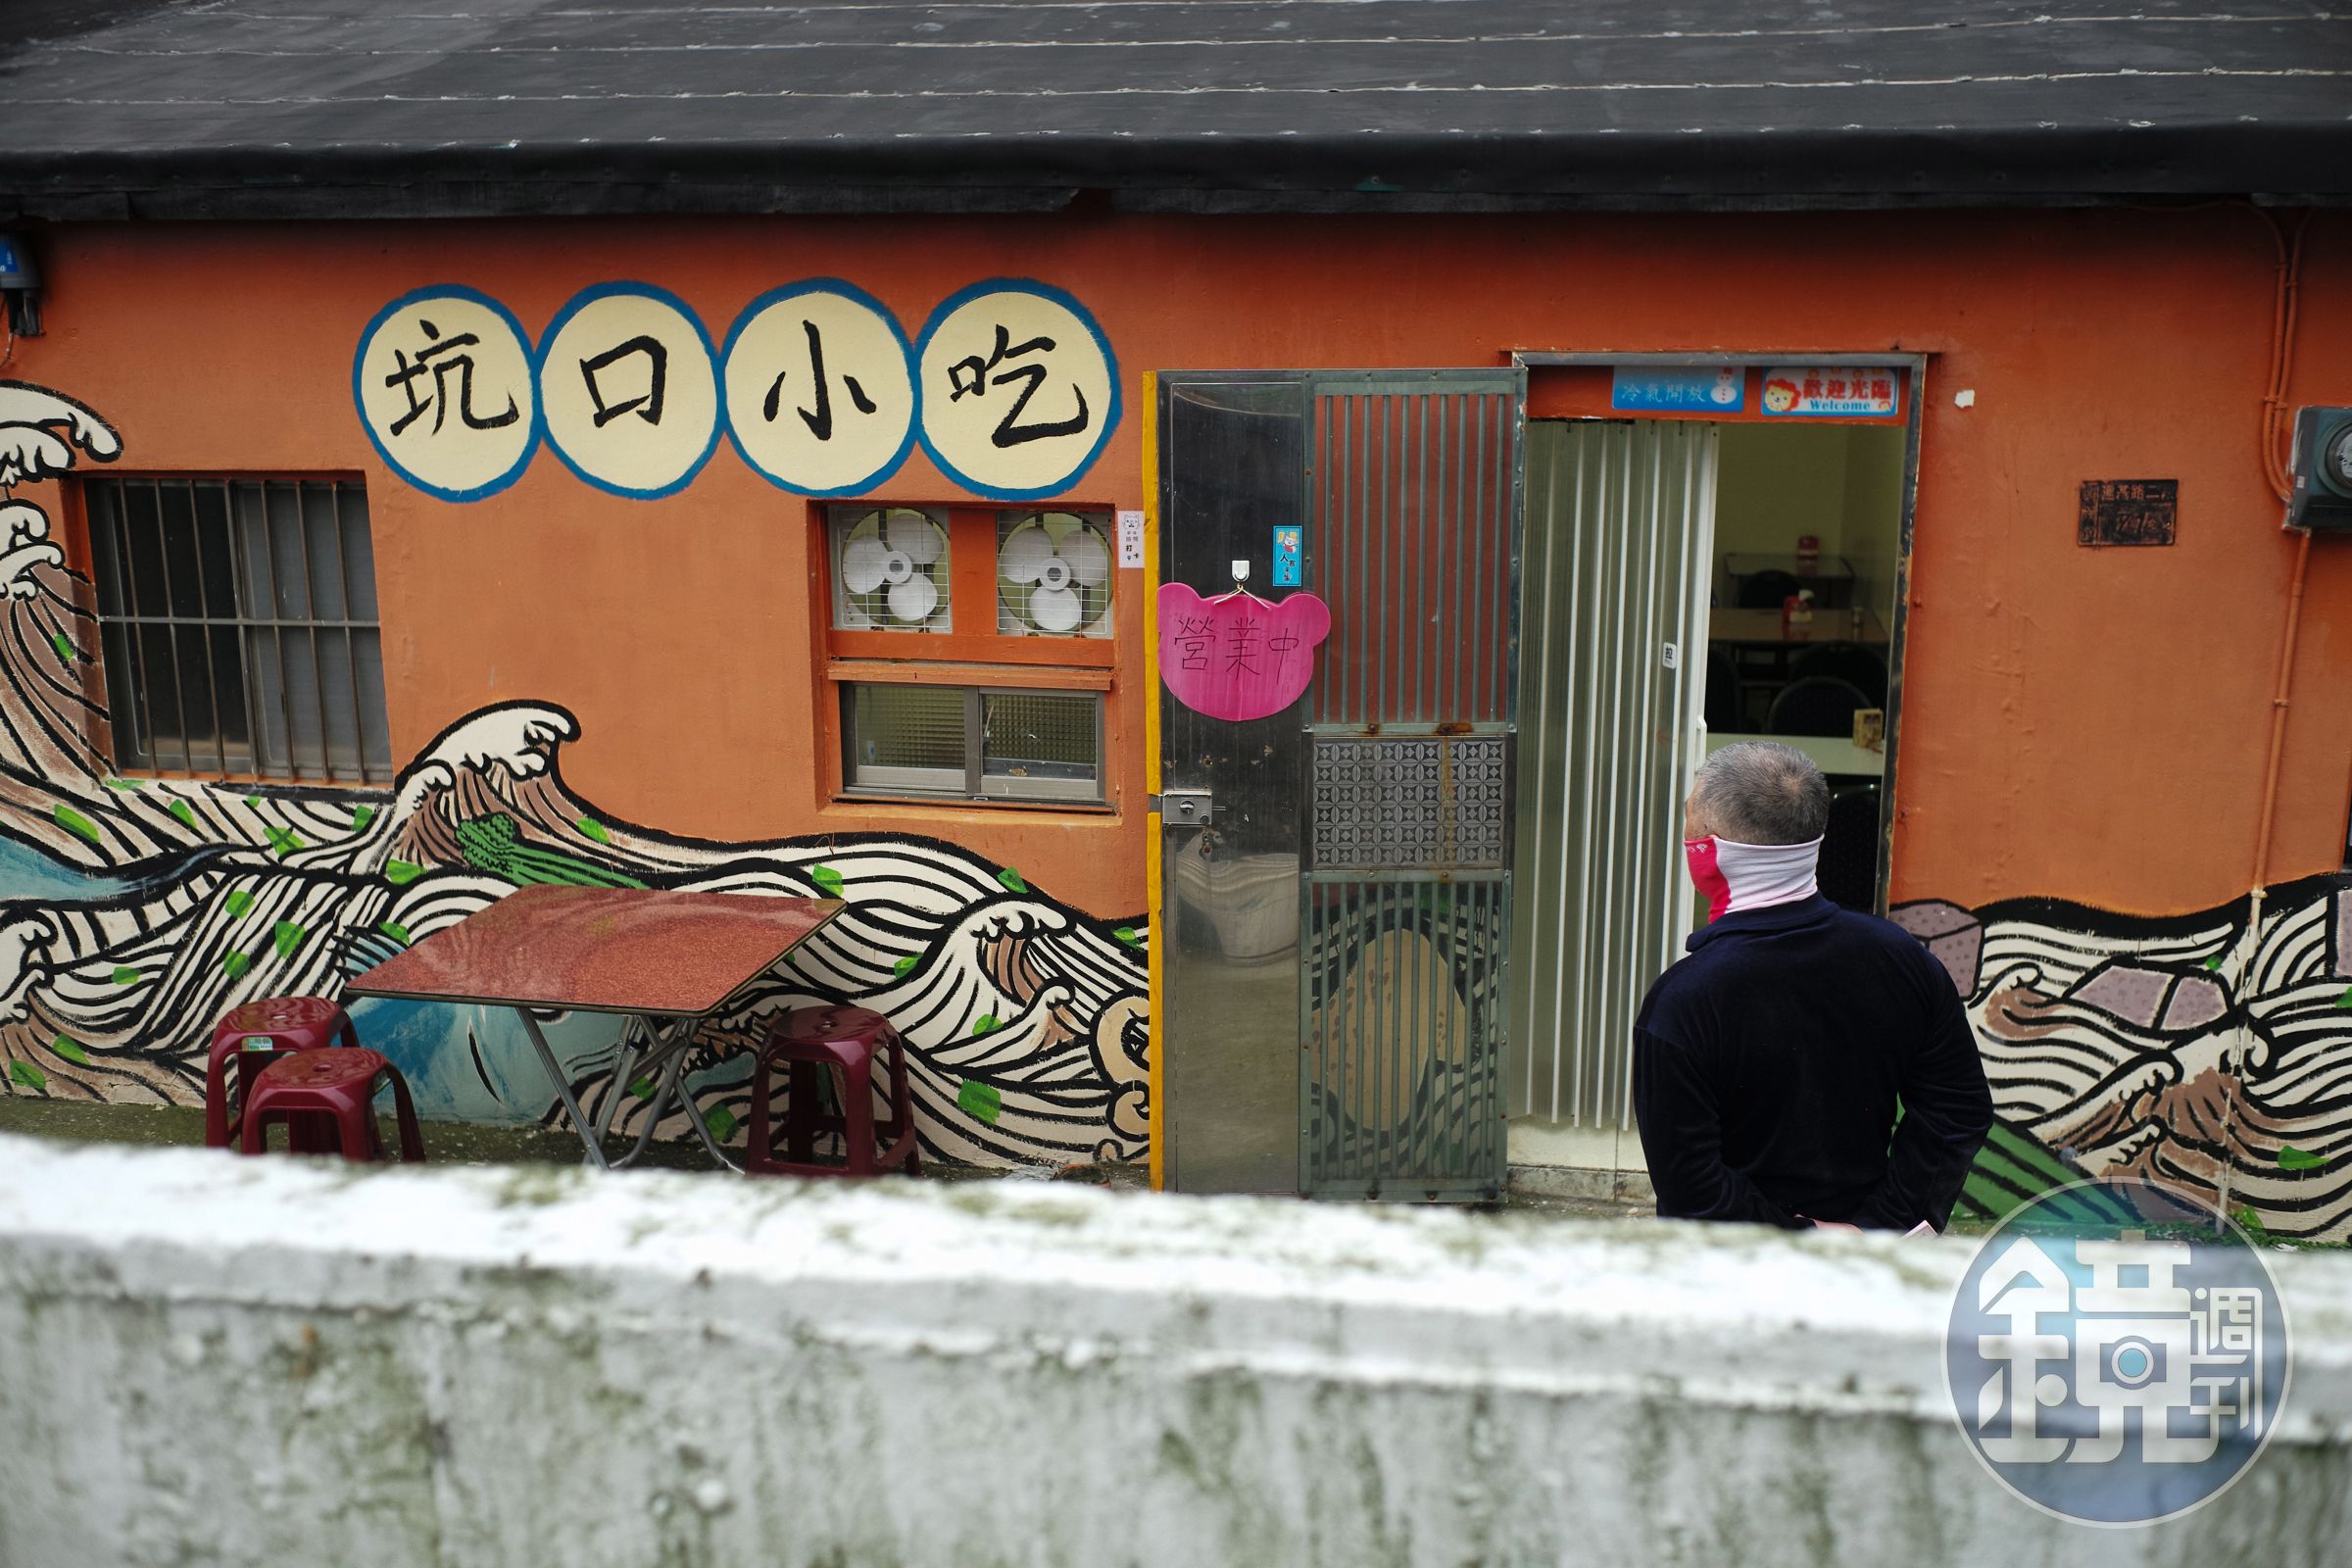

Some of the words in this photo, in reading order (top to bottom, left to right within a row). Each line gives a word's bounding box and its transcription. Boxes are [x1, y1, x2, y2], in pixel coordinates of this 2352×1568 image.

[386, 319, 1088, 448] 坑口小吃
[1622, 382, 1705, 403] 冷氣開放
[1803, 378, 1891, 400] 歡迎光臨
[1810, 399, 1871, 411] Welcome
[1175, 615, 1299, 685] 營業中
